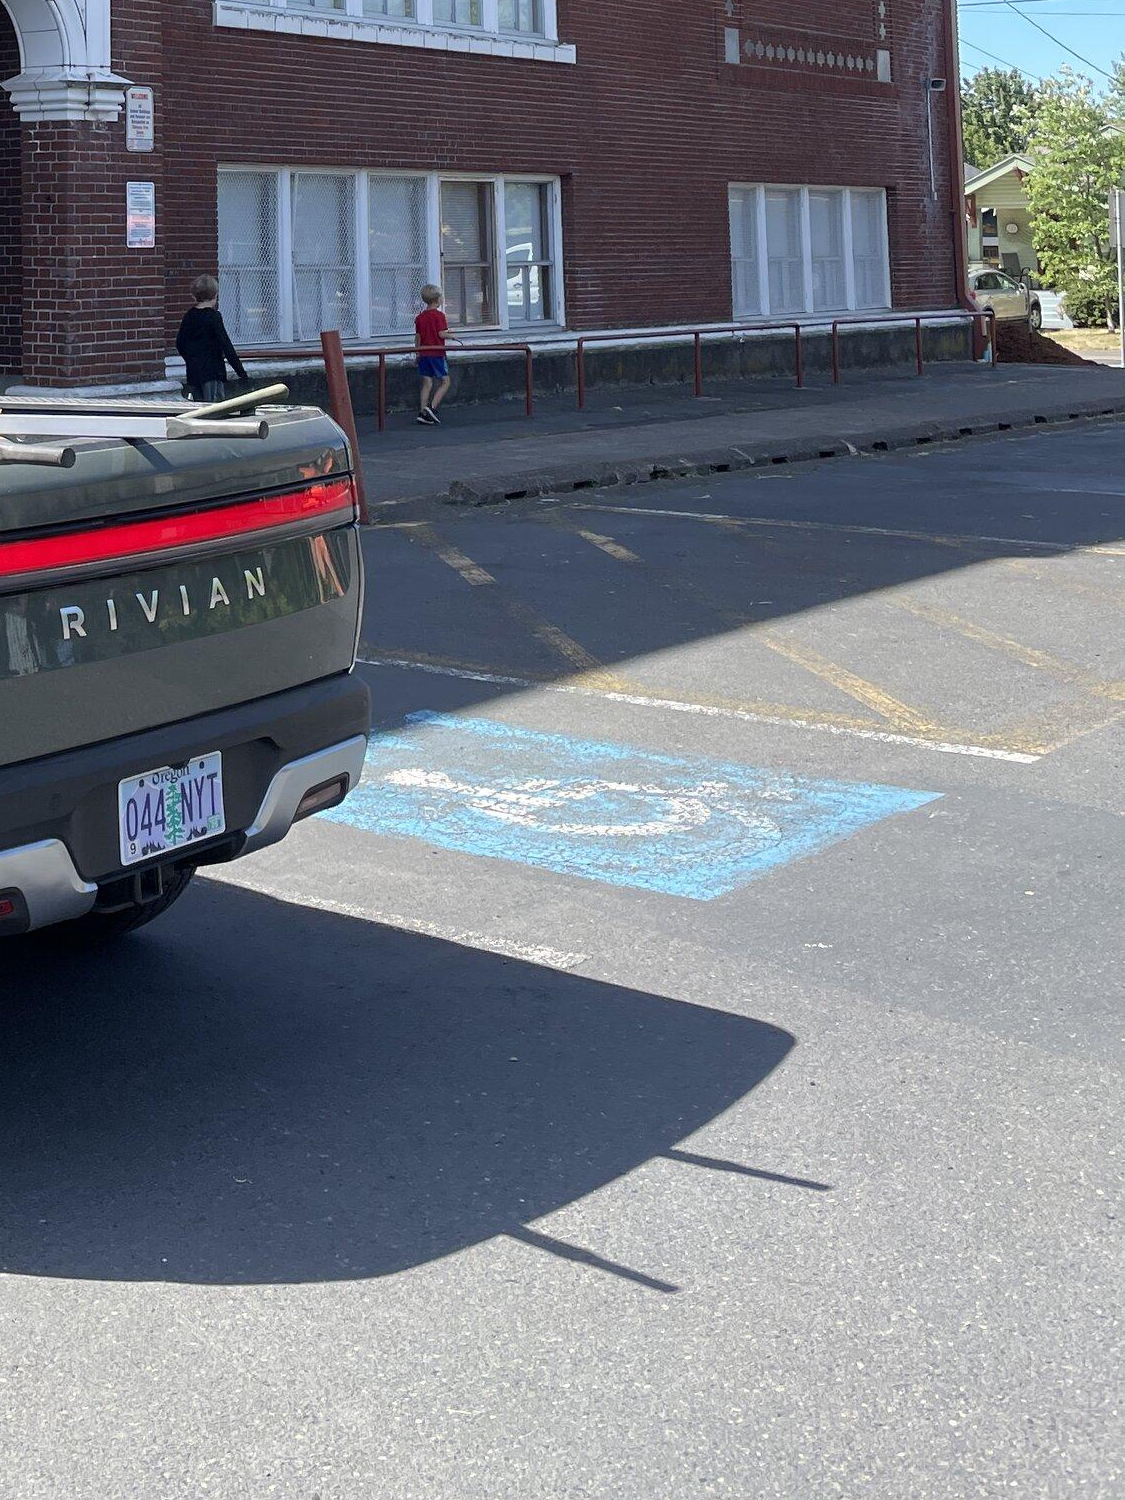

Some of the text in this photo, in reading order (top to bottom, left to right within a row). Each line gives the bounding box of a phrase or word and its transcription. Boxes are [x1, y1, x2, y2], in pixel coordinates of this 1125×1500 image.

[59, 566, 266, 640] RIVIAN
[152, 765, 190, 784] Oregon
[126, 772, 218, 842] 044 NYT
[129, 842, 137, 855] 9
